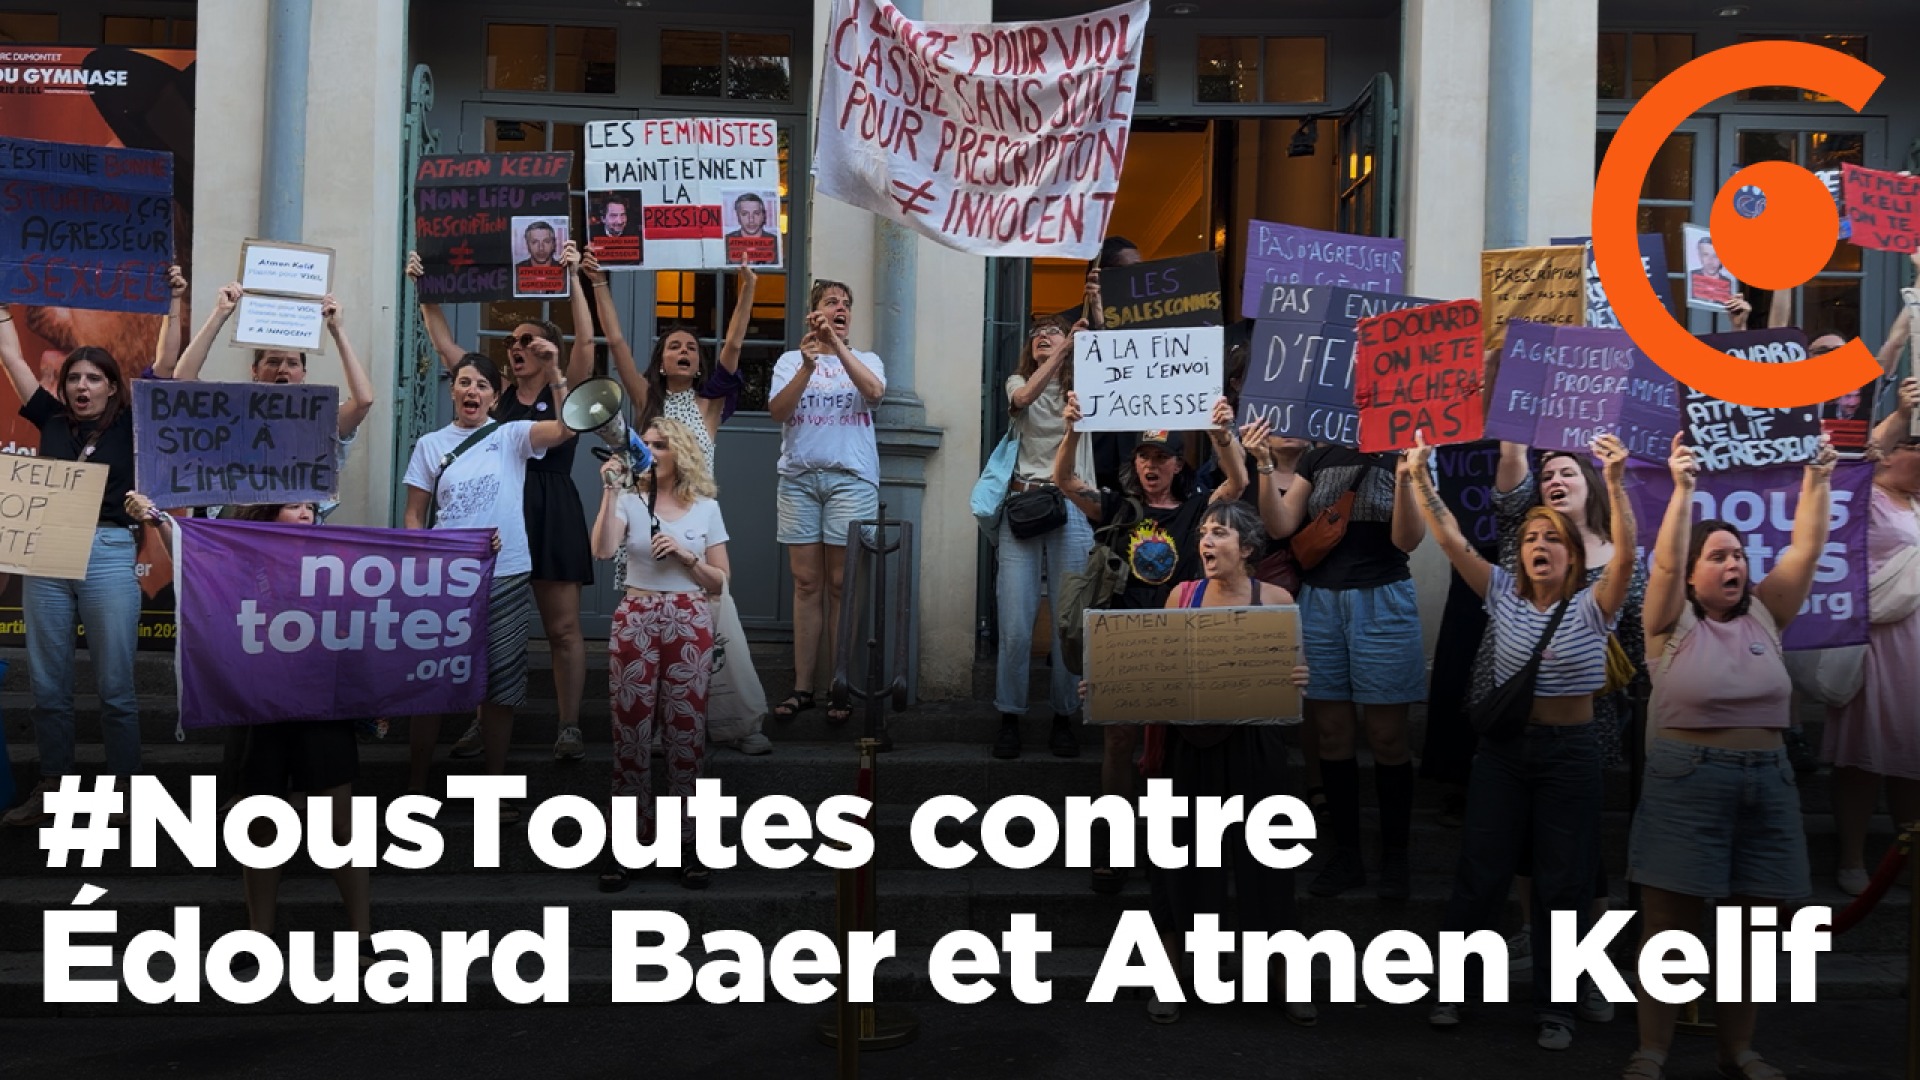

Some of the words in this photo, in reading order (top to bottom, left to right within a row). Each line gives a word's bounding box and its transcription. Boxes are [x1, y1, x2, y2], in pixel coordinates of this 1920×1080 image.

[969, 27, 1049, 75] POUR
[1052, 14, 1130, 70] VIOL
[23, 68, 128, 86] GYMNASE
[953, 75, 1042, 133] SANS
[588, 121, 635, 148] LES
[644, 117, 774, 147] FEMINISTES
[840, 81, 924, 161] POUR
[933, 120, 1127, 187] PRESCRIPTION
[60, 150, 98, 175] UNE
[105, 153, 168, 177] BONNE
[417, 157, 492, 181] ATMEN
[500, 156, 568, 178] KELIF
[605, 157, 768, 184] MAINTIENNENT
[662, 184, 691, 204] LA
[417, 213, 508, 239] PRESCRIPTION
[644, 205, 721, 230] PRESSION
[942, 189, 1117, 243] INNOCENT
[1887, 215, 1914, 232] TE
[21, 216, 170, 255] AGRESSEUR
[1258, 225, 1296, 261] PAS
[418, 267, 509, 295] INNOCENCE
[1130, 267, 1180, 298] LES
[1268, 286, 1314, 314] PAS
[1361, 305, 1480, 346] EDOUARD
[1112, 337, 1139, 360] LA
[1151, 332, 1191, 358] FIN
[1374, 346, 1411, 375] ON
[1510, 338, 1636, 371] AGRESSEURS
[1104, 365, 1134, 384] DE
[1146, 356, 1211, 379] L'ENVOI
[796, 392, 853, 408] CTIMES
[1372, 368, 1480, 408] LACHERA
[249, 389, 330, 421] KELIF
[1245, 403, 1294, 433] NOS
[156, 425, 232, 454] STOP
[252, 423, 276, 450] À
[1389, 402, 1462, 445] PAS
[1689, 416, 1775, 444] KELIF
[10, 460, 86, 491] KELIF
[170, 453, 331, 493] L'IMPUNITÉ
[0, 492, 48, 521] OP
[300, 554, 482, 598] nous
[236, 599, 472, 656] toutes
[1094, 613, 1168, 635] ATMEN
[1184, 610, 1248, 630] KELIF
[406, 653, 472, 684] .org
